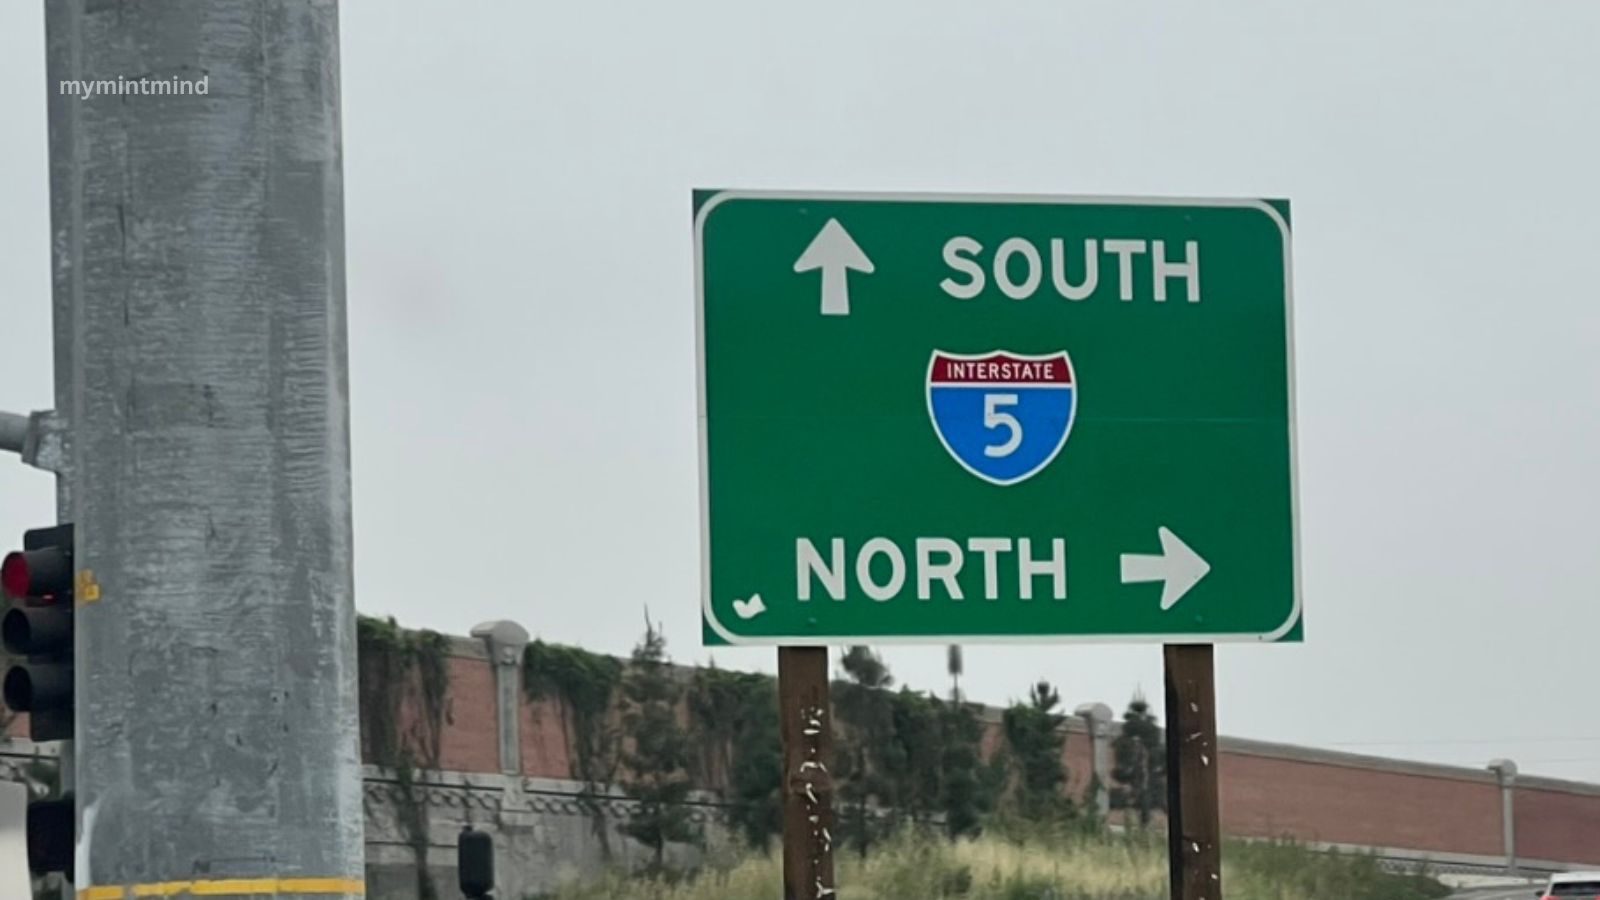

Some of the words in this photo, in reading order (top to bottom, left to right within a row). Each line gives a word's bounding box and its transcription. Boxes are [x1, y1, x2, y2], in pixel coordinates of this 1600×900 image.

[939, 236, 1200, 302] SOUTH
[946, 362, 1054, 380] INTERSTATE
[983, 393, 1023, 458] 5
[796, 537, 1067, 601] NORTH
